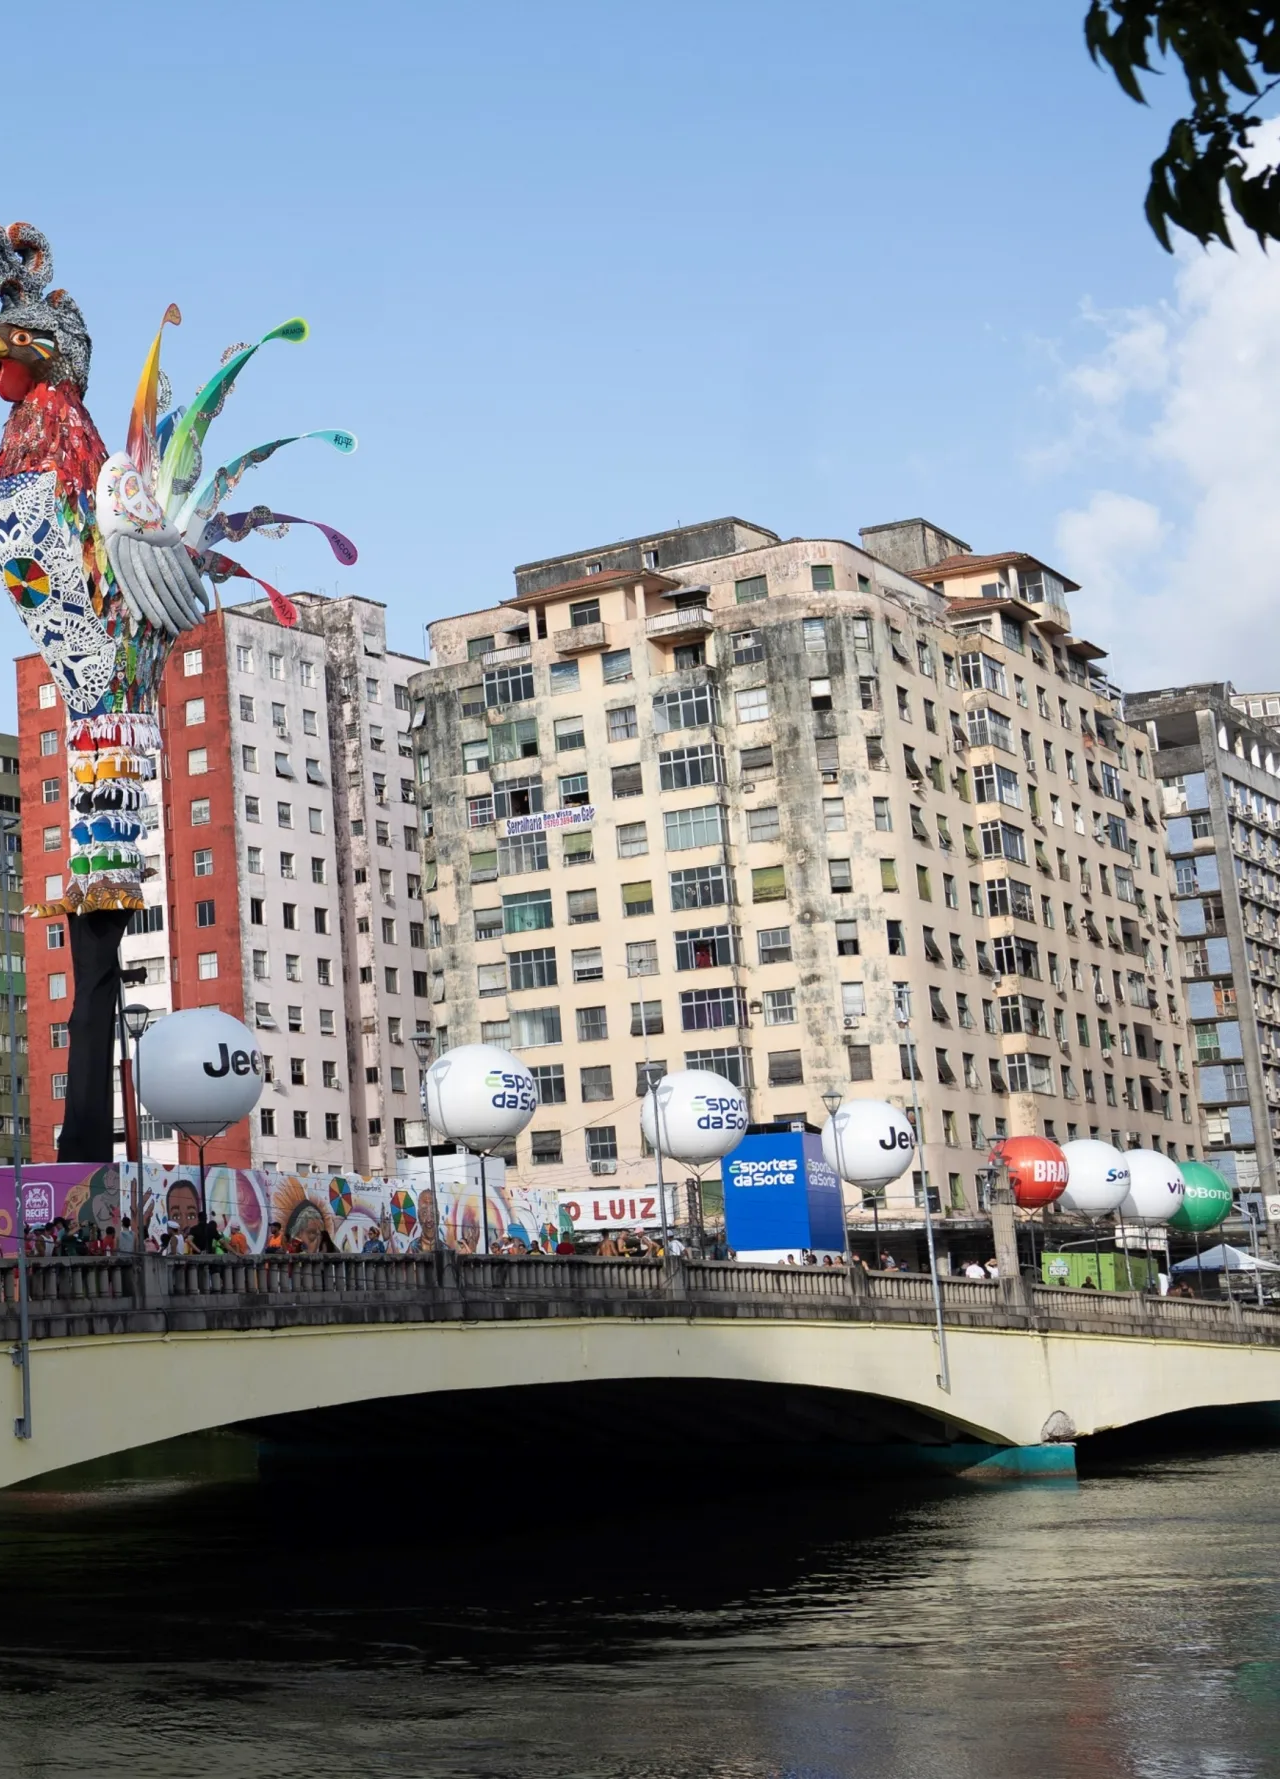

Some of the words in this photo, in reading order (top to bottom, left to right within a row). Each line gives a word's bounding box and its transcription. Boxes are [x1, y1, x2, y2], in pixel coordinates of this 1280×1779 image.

[274, 596, 296, 624] PAIX
[506, 815, 543, 835] Serralharia
[203, 1043, 263, 1081] Jee
[729, 1159, 798, 1175] Esportes
[25, 1208, 49, 1218] RECIFE
[593, 1197, 656, 1220] LUIZ
